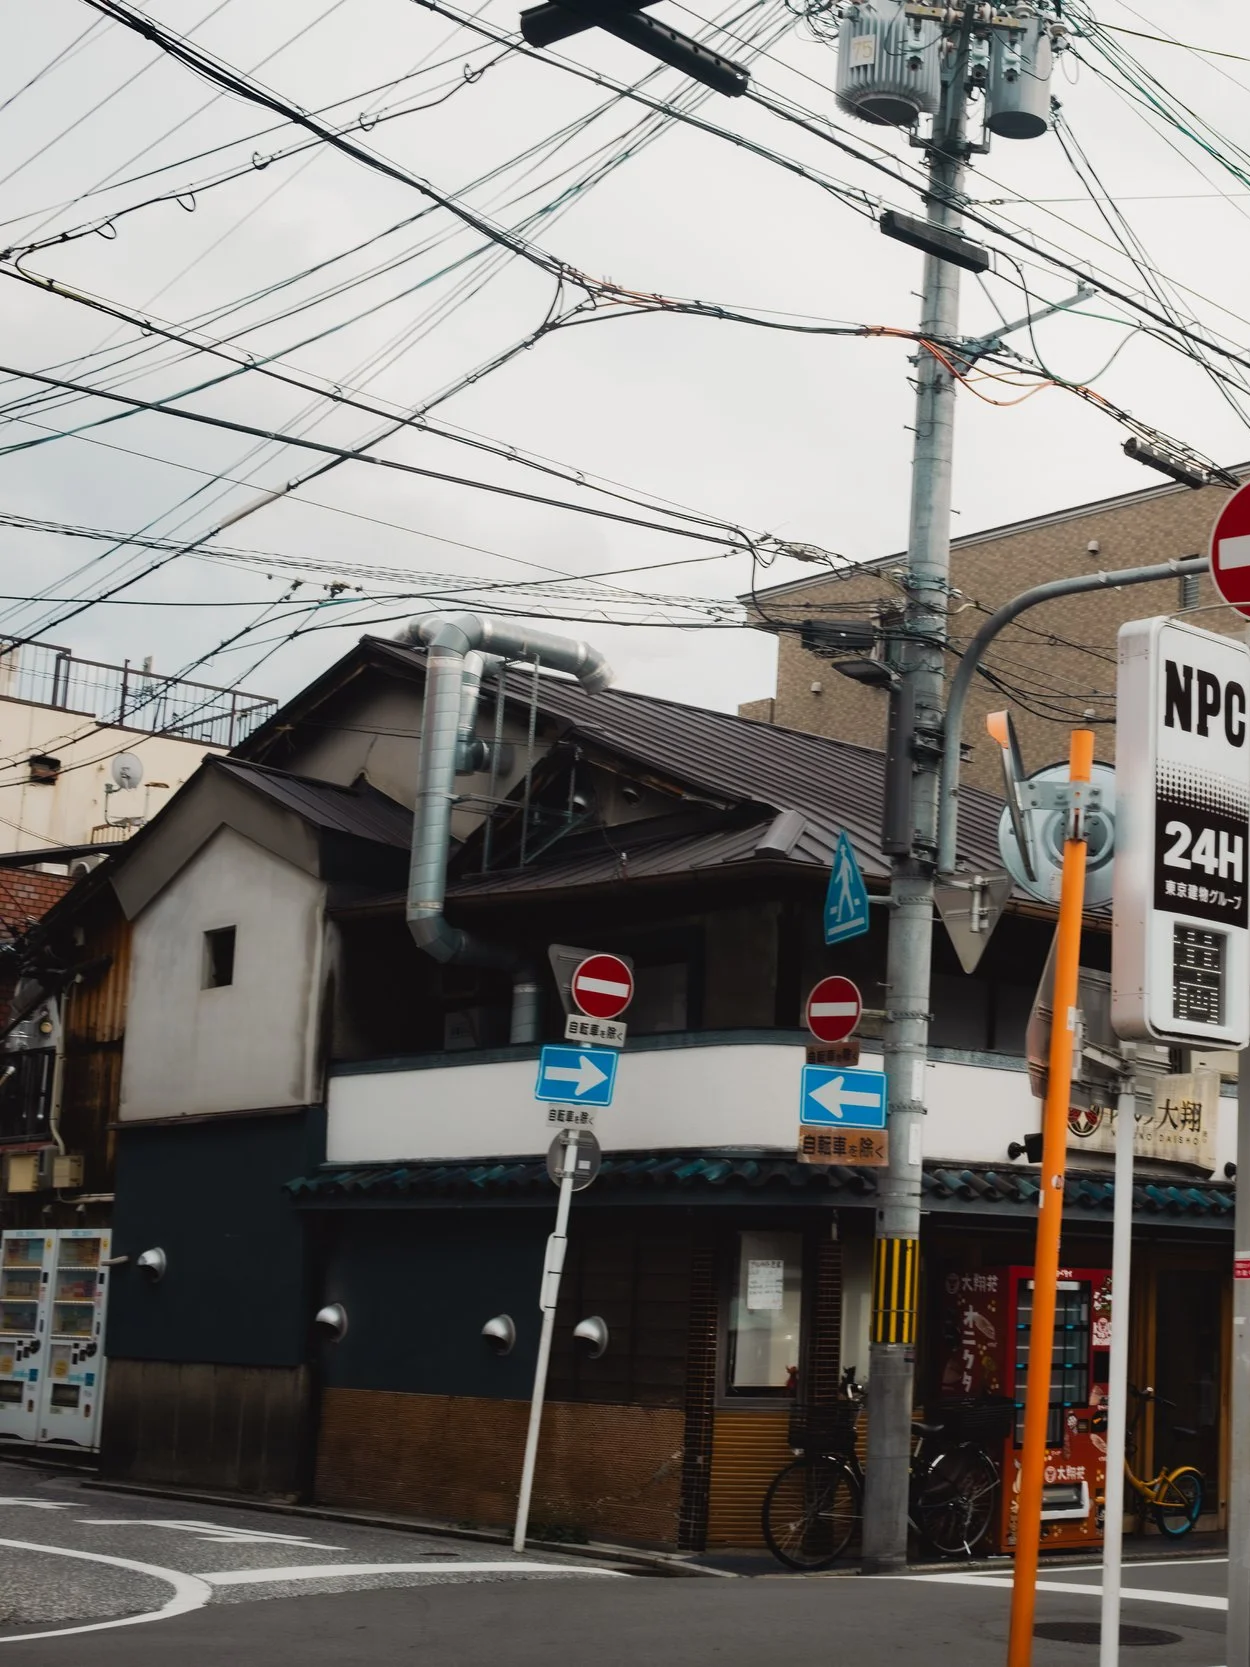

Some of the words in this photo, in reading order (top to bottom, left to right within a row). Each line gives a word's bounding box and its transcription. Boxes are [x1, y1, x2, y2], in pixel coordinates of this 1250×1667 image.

[1164, 660, 1246, 748] NPC
[1163, 820, 1244, 884] 24H
[1164, 879, 1243, 911] 東京建物グループ
[568, 1021, 624, 1041] 自転車を除く
[548, 1109, 595, 1126] 自転車を除く
[803, 1134, 884, 1159] 自転車を除く
